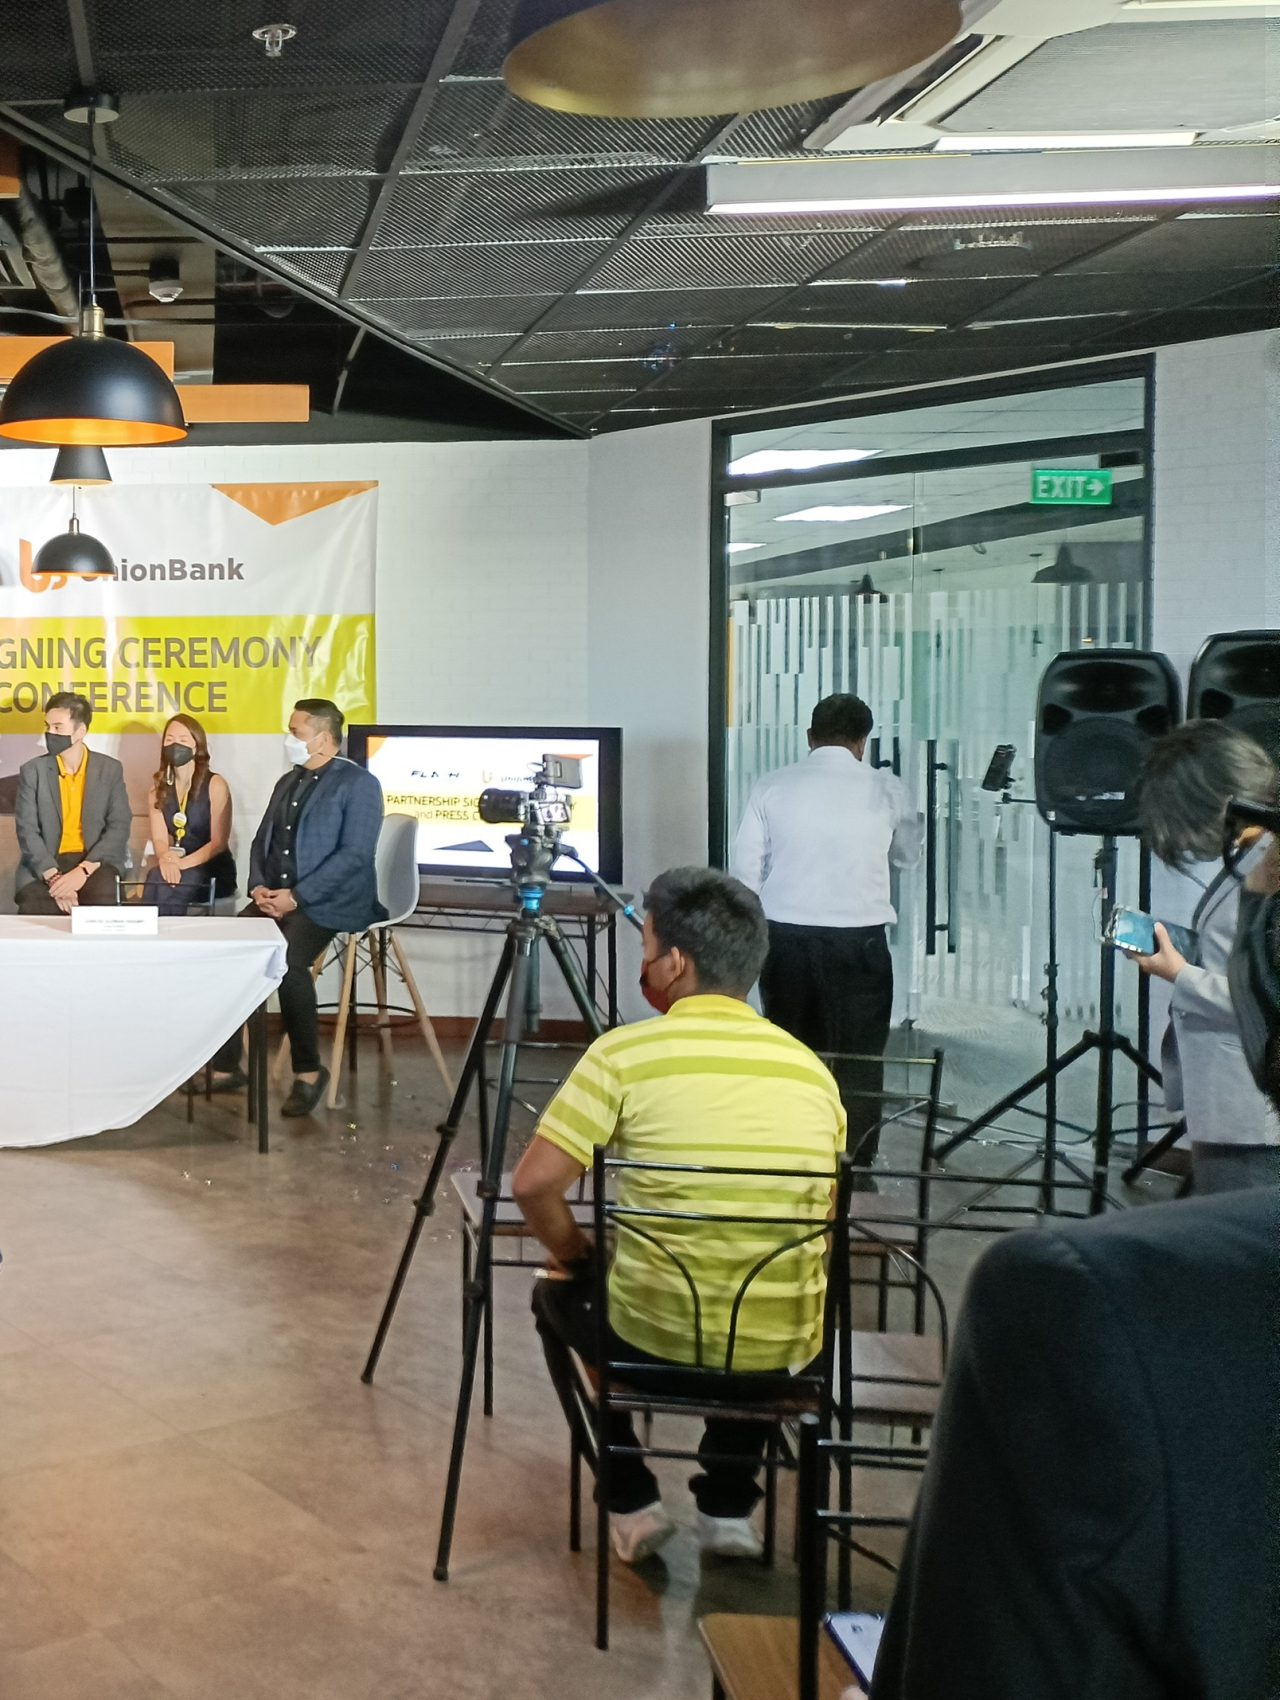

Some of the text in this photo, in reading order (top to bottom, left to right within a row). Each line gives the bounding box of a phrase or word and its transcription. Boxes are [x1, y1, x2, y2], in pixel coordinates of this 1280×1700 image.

[1036, 475, 1088, 498] EXIT
[80, 557, 245, 582] ionBank
[119, 636, 322, 669] CEREMONY
[411, 770, 460, 779] FLAH
[386, 795, 461, 807] PARTNERSHIP
[435, 809, 470, 821] PRESS
